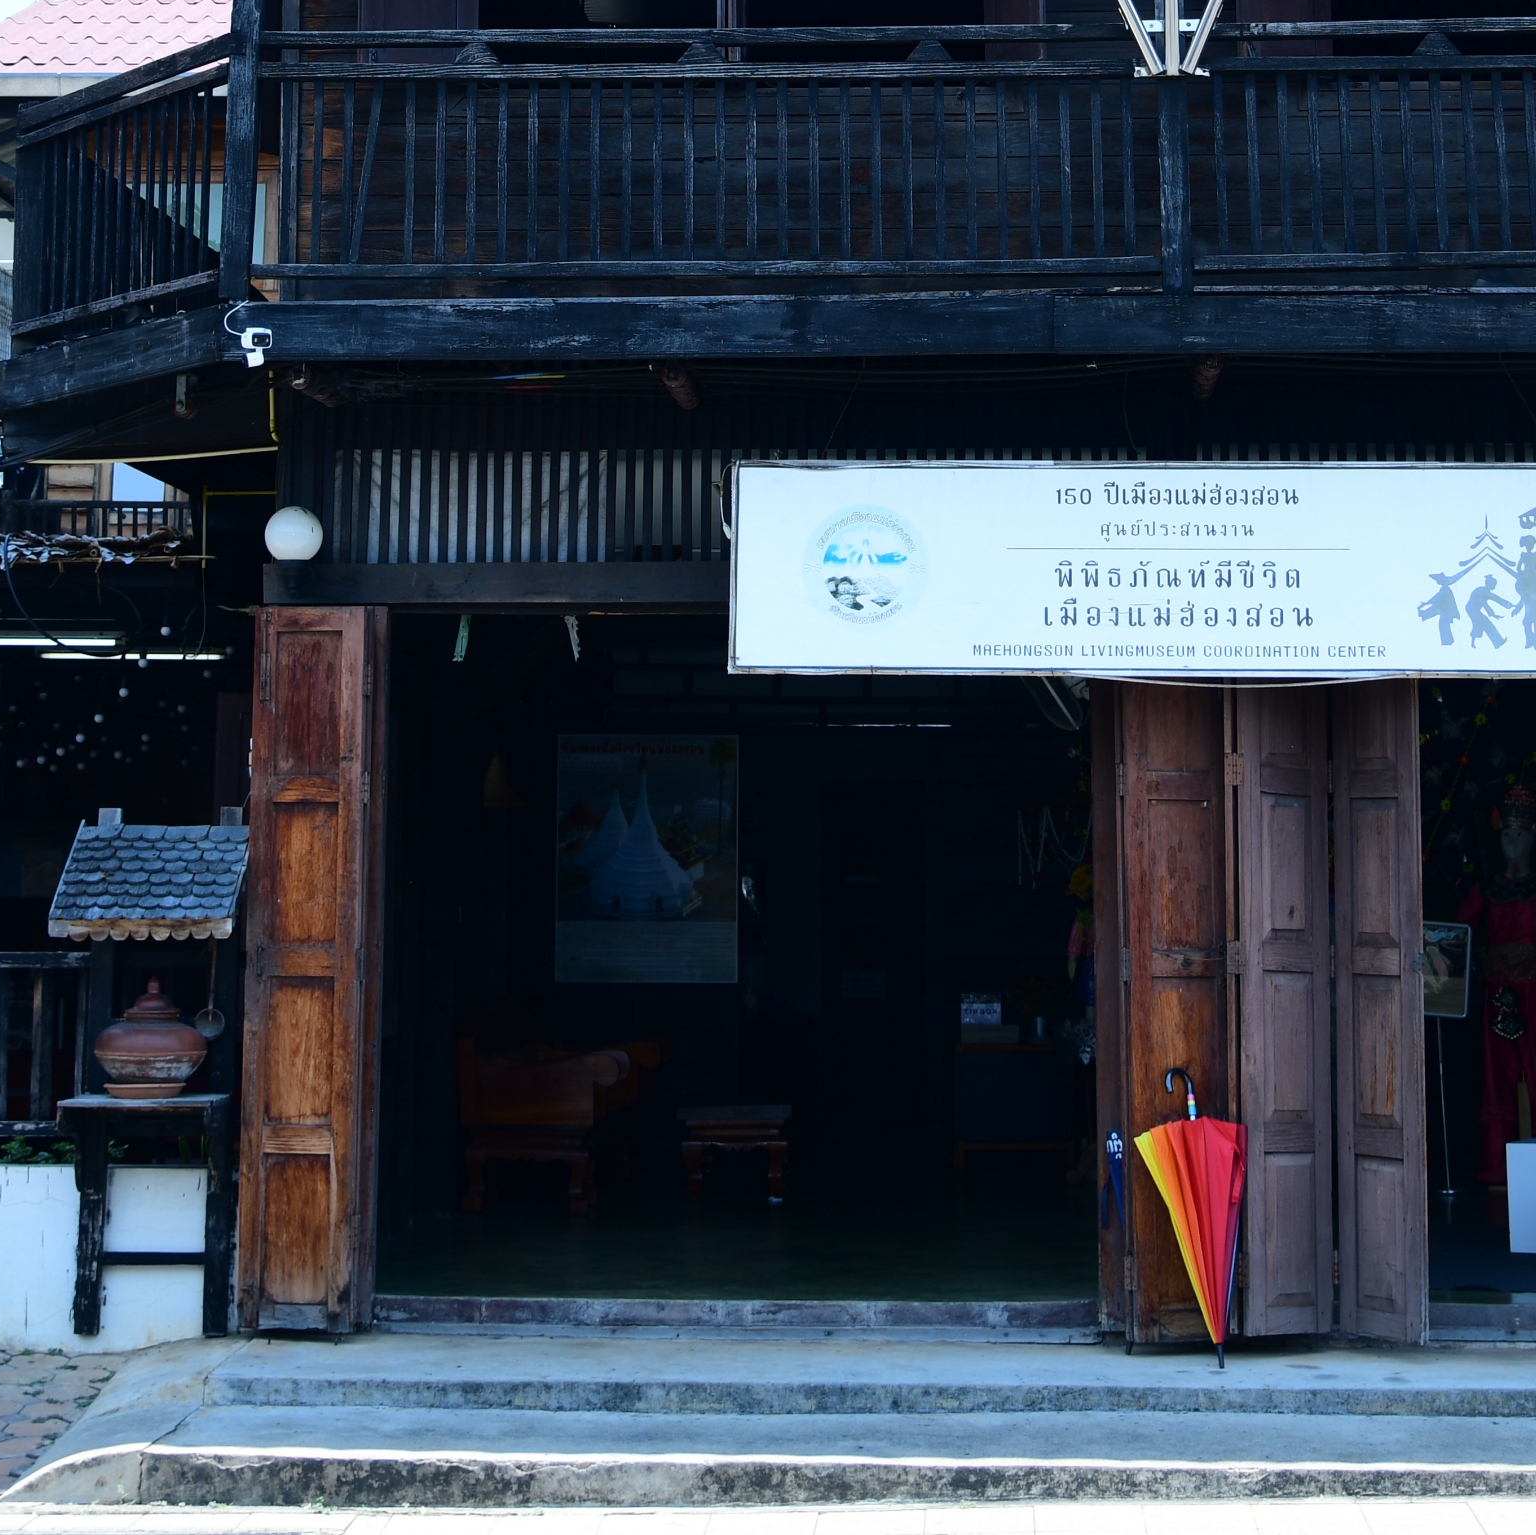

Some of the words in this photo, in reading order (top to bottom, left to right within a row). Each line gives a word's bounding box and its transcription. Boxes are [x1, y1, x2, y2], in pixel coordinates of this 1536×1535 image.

[1056, 487, 1092, 506] 150
[1103, 481, 1300, 506] ปีเมืองแม่ฮ่องสอน
[1100, 519, 1255, 542] ศูนย์ประสานงาน
[1054, 559, 1301, 589] พิพิธภัณฑ์มีชีวิต
[1044, 597, 1314, 628] เมืองแม่ฮ่องสอน
[972, 644, 1074, 657] MAEHONGSON
[1081, 644, 1196, 658] LIVINGMUSEUM
[1203, 645, 1321, 658] COORDINATION
[1327, 645, 1387, 658] CENTER
